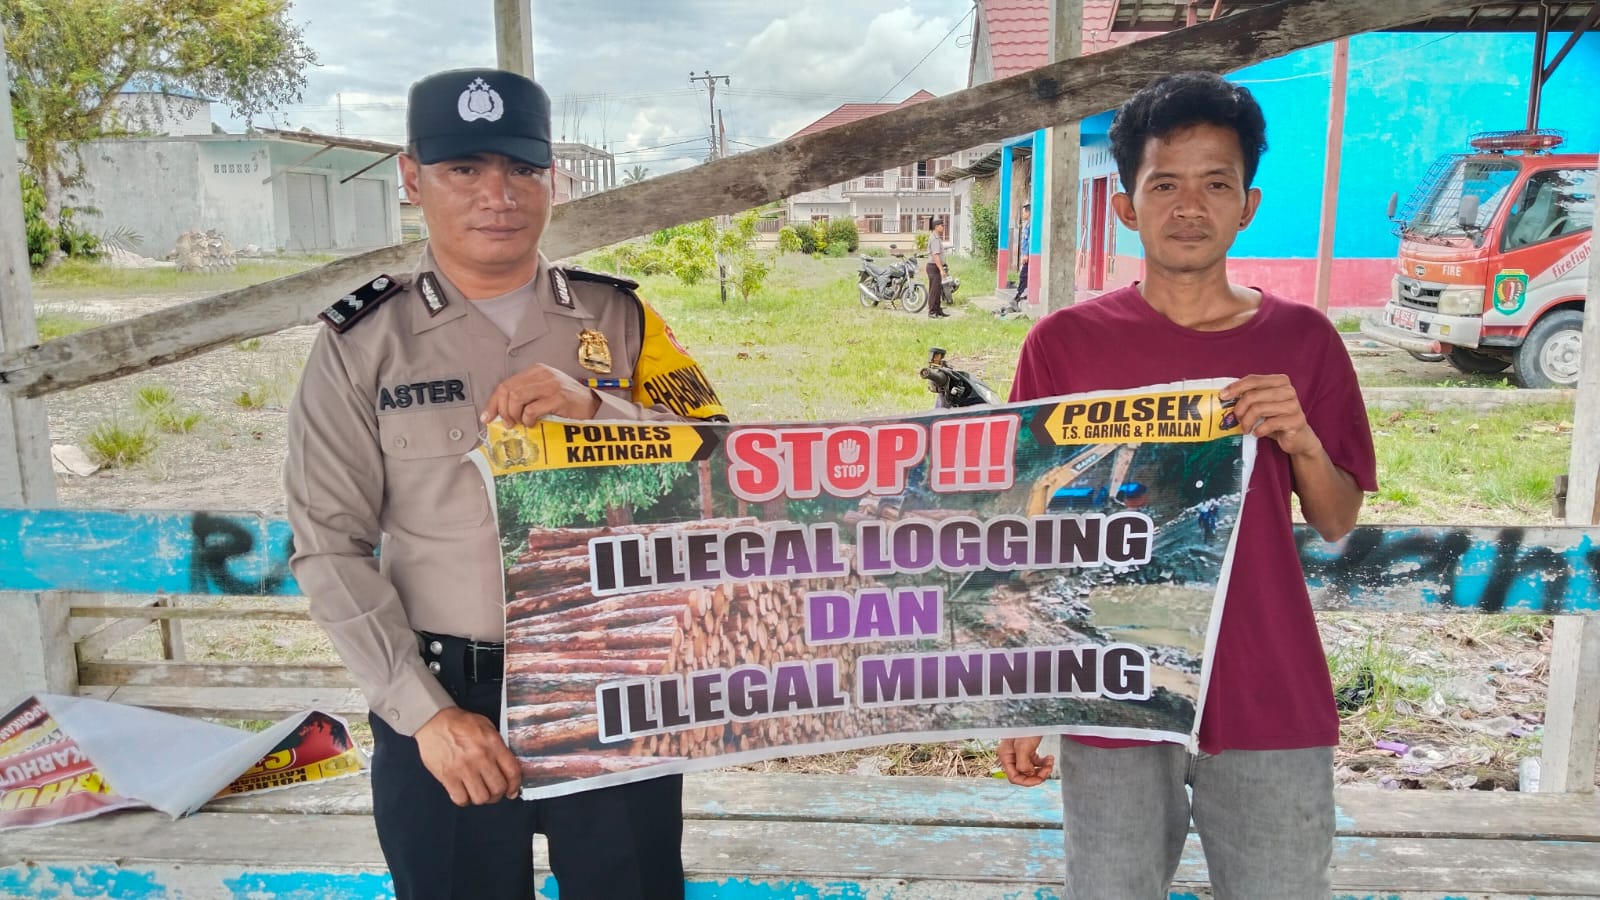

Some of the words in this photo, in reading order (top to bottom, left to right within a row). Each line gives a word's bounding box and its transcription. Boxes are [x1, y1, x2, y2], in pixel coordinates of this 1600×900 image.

[1442, 264, 1462, 277] FIRE
[379, 379, 466, 411] ASTER
[1062, 394, 1204, 425] POLSEK
[563, 424, 672, 443] POLRES
[1062, 425, 1081, 440] T.S.
[1084, 423, 1131, 439] GARING
[1133, 424, 1143, 438] &
[1146, 423, 1156, 438] P.
[1157, 421, 1201, 438] MALAN
[566, 443, 673, 463] KATINGAN
[730, 425, 923, 498] STOP
[834, 464, 865, 479] STOP
[591, 525, 845, 593] ILLEGAL
[861, 515, 1151, 574] LOGGING
[808, 588, 941, 643] DAN
[598, 661, 846, 739] ILLEGAL
[860, 646, 1150, 701] MINNING
